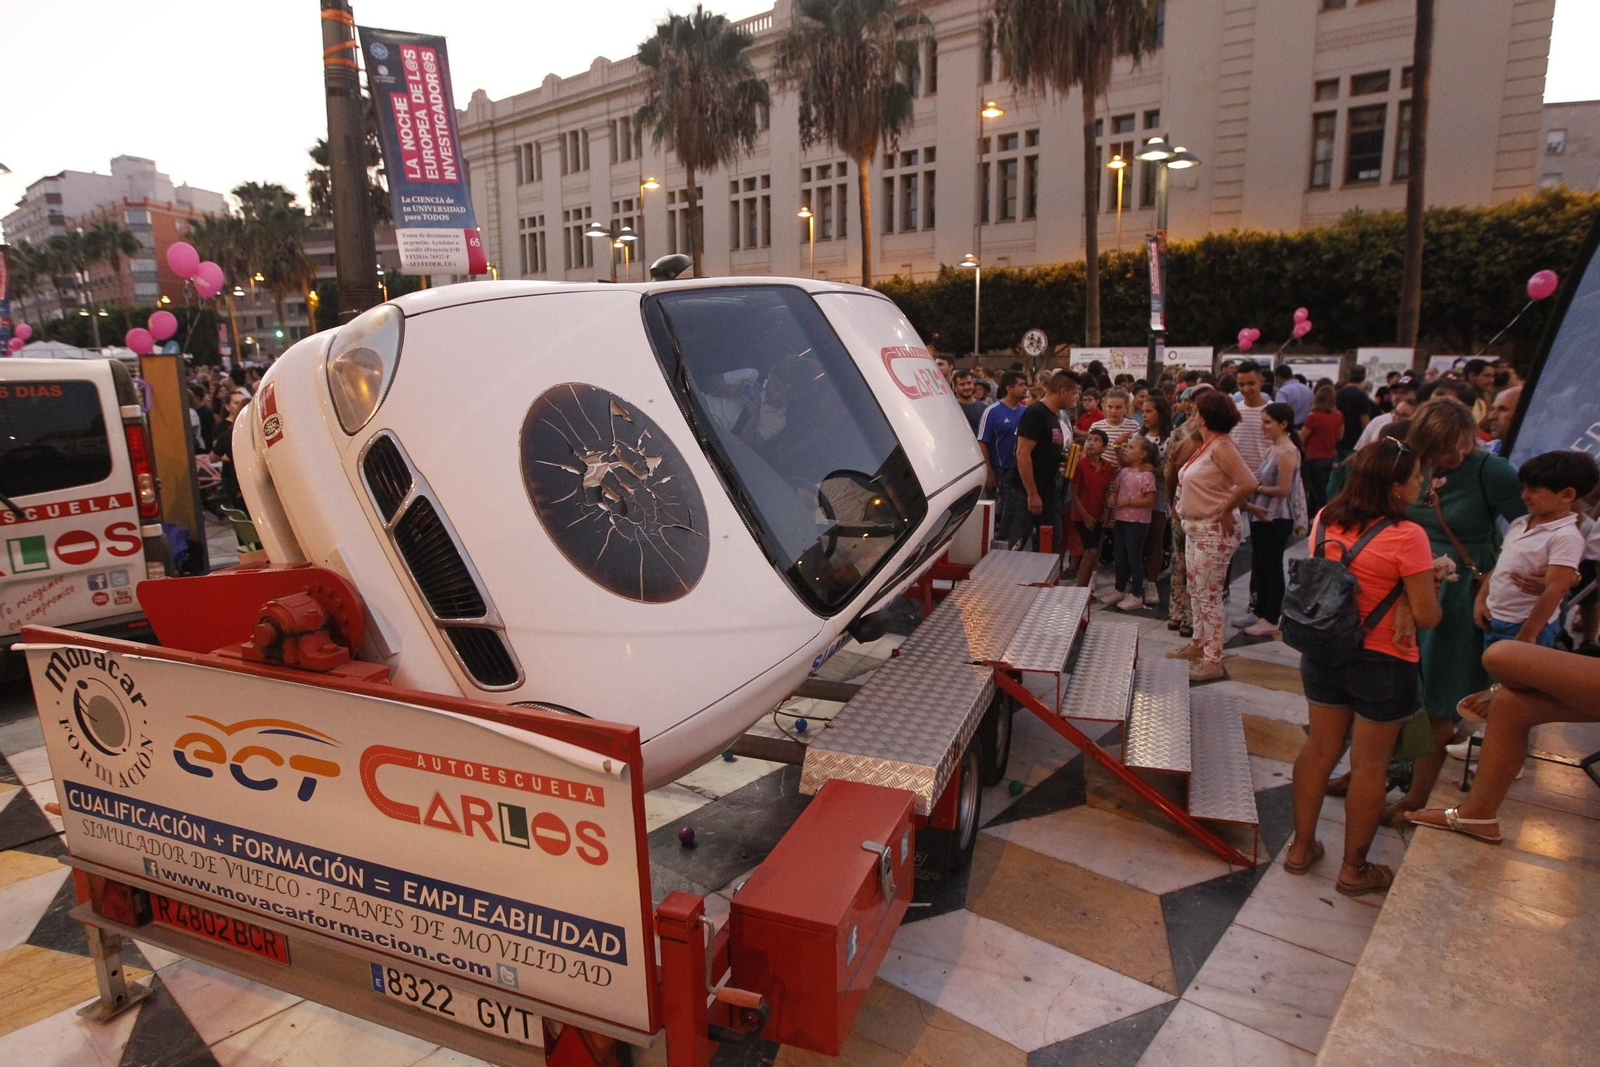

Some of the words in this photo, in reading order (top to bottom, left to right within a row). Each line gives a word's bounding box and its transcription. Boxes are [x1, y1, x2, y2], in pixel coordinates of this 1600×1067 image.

[403, 49, 421, 82] L@S
[410, 83, 426, 104] DE
[421, 51, 457, 180] INVESTIGADOR@S
[394, 97, 416, 150] NOCHE
[416, 109, 439, 180] EUROPEA
[408, 158, 421, 180] LA
[401, 196, 411, 204] La
[412, 196, 445, 204] CIENCIA
[413, 205, 466, 213] UNIVERSIDAD
[469, 238, 480, 247] 65
[15, 385, 63, 398] DIAS
[0, 522, 142, 575] LOS
[359, 744, 609, 866] CARLOS
[417, 754, 596, 803] AUTOESCUELA
[69, 789, 206, 844] CUALIFICACIÓN
[232, 833, 364, 889] FORMACIÓN
[403, 880, 621, 956] EMPLEABILIDAD
[82, 819, 189, 865] SIMULADOR
[191, 851, 218, 874] DE
[220, 857, 300, 898] VUELCO
[316, 887, 404, 929] PLANES
[410, 914, 445, 941] DE
[452, 926, 612, 988] MOVILIDAD
[161, 869, 492, 979] www.movacarformacion.com
[387, 967, 455, 1016] 8322
[477, 998, 533, 1039] GYT
